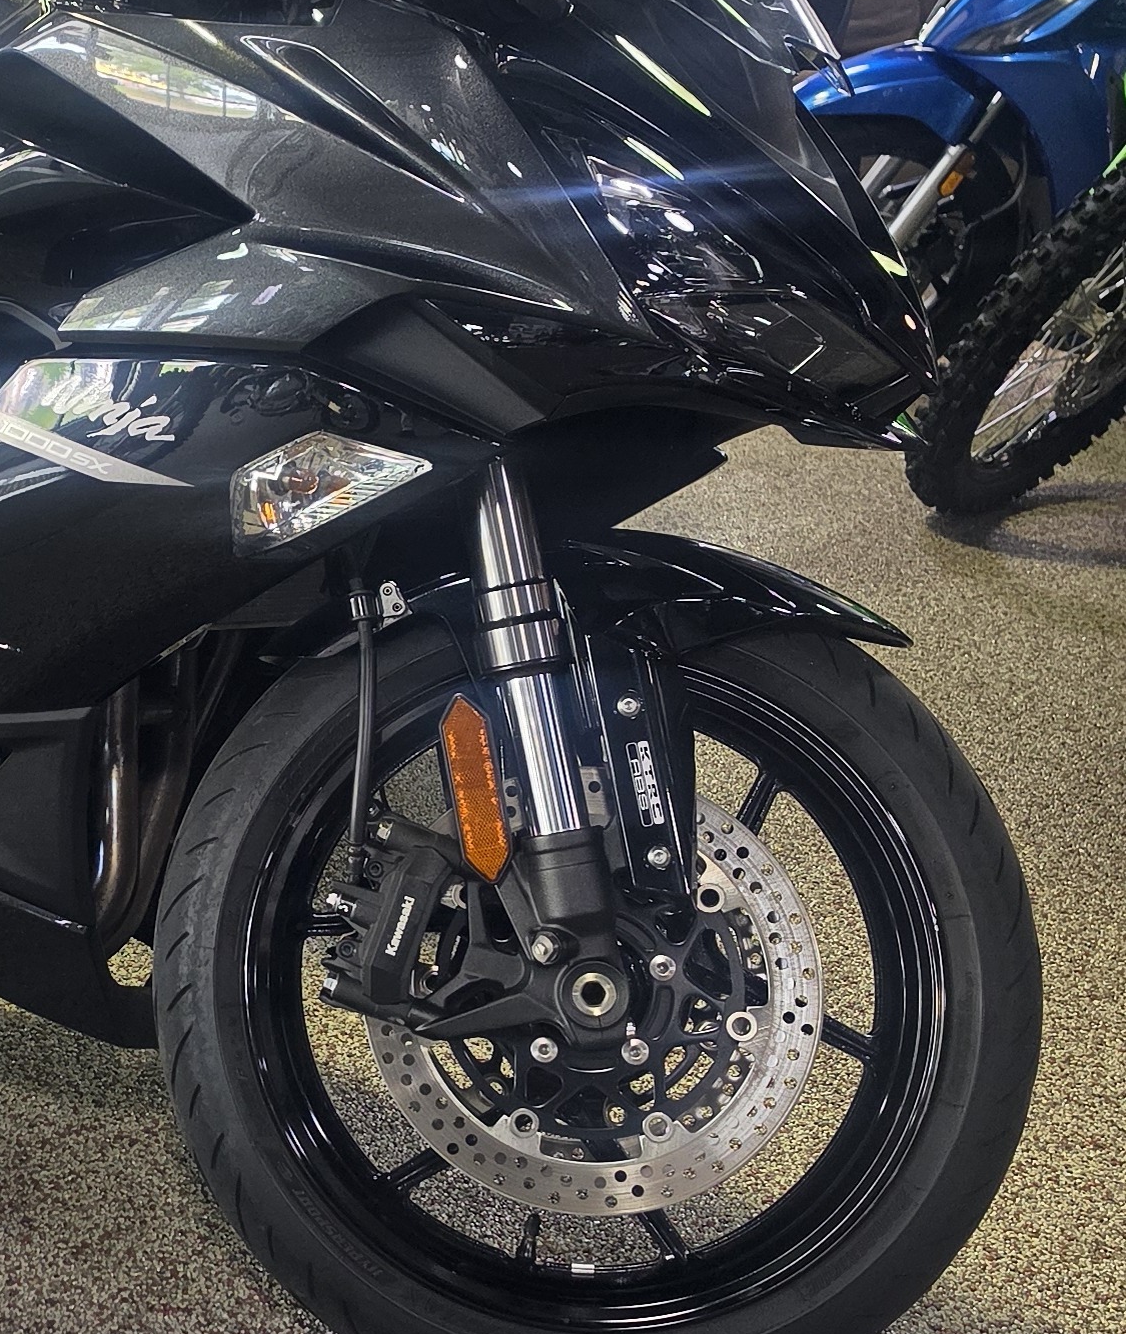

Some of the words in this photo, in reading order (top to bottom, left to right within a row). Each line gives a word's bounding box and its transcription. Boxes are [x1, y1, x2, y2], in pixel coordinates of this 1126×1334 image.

[41, 373, 175, 441] Ninja
[630, 758, 649, 811] ABS
[640, 746, 663, 819] KTRC
[385, 895, 415, 956] Kawasaki
